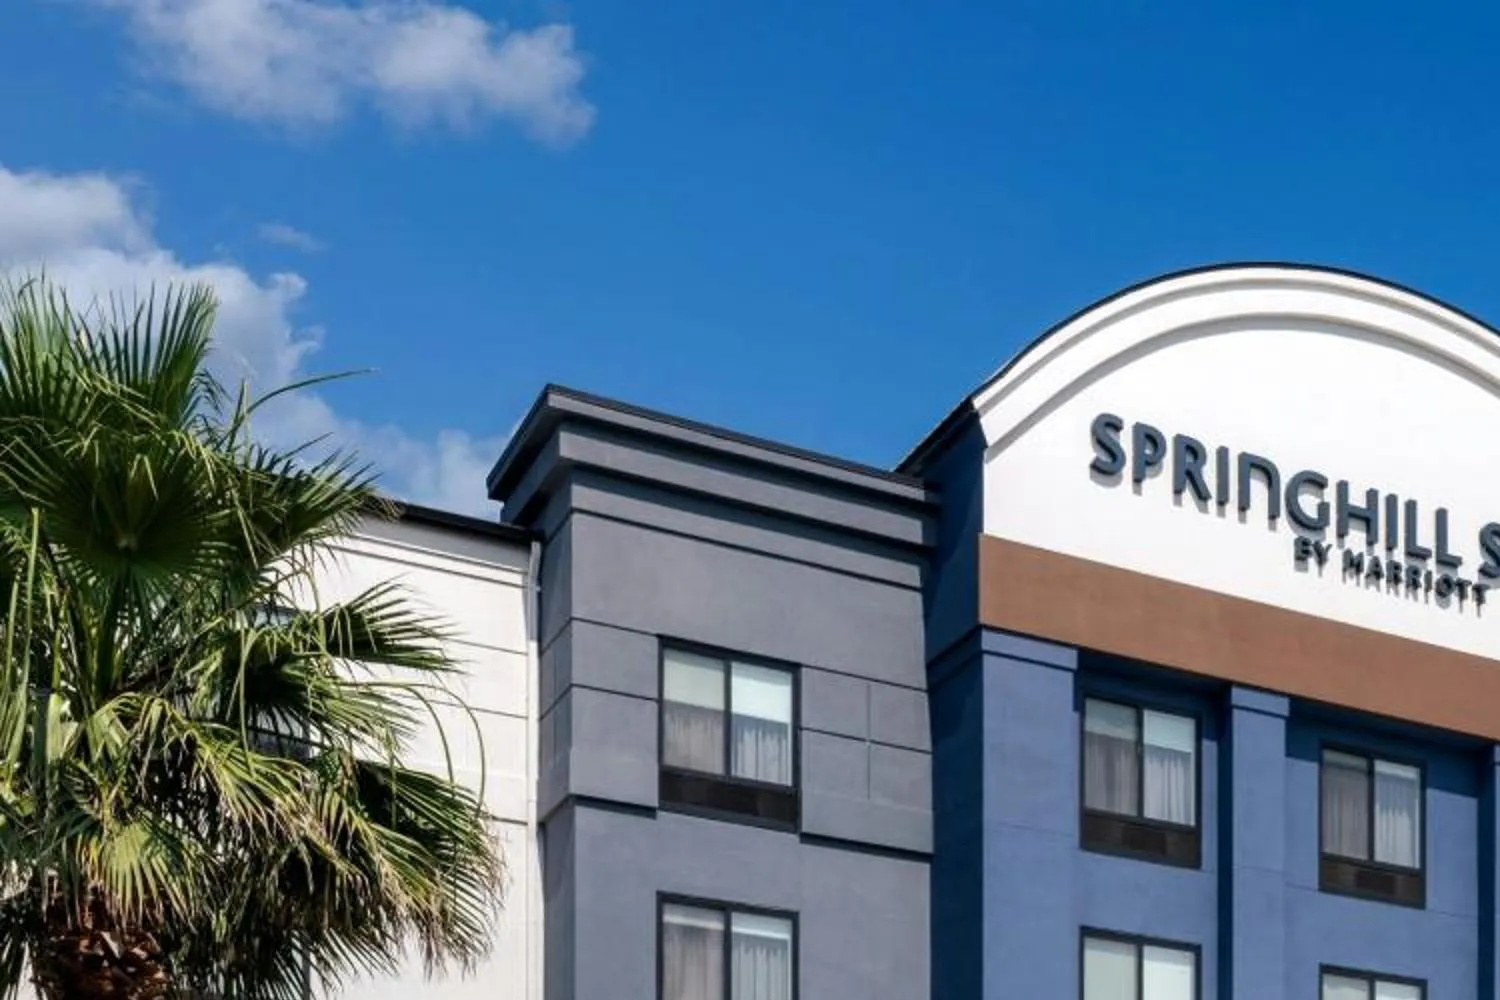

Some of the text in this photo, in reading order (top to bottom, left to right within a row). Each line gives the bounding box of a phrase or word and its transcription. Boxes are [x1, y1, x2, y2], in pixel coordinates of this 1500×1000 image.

[1089, 413, 1462, 569] SPRINGHILL
[1294, 536, 1491, 606] BY MARRIOTT
